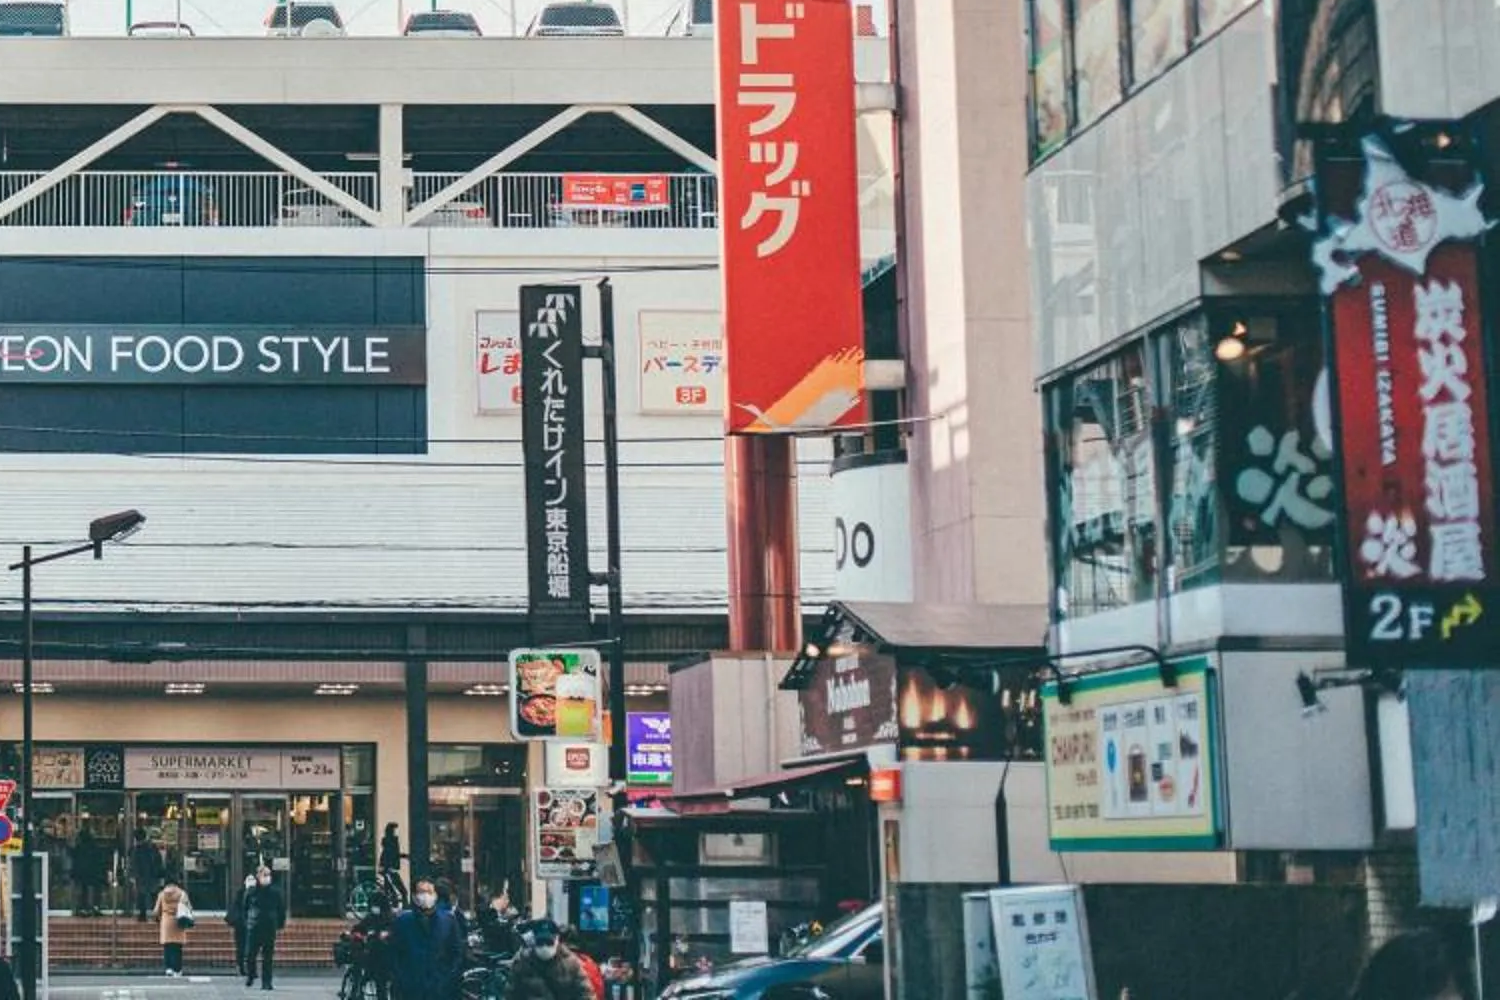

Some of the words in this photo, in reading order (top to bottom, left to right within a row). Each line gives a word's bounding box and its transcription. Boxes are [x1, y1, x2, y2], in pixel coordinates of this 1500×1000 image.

[1370, 281, 1390, 362] SUMIBI
[111, 335, 245, 373] FOOD
[257, 335, 391, 374] STYLE
[681, 388, 702, 404] 3F
[1377, 369, 1397, 466] IZAKAYA
[1413, 279, 1486, 580] 炭火居酒屋
[1369, 593, 1434, 640] 2F
[150, 755, 253, 769] SUPERMARKET
